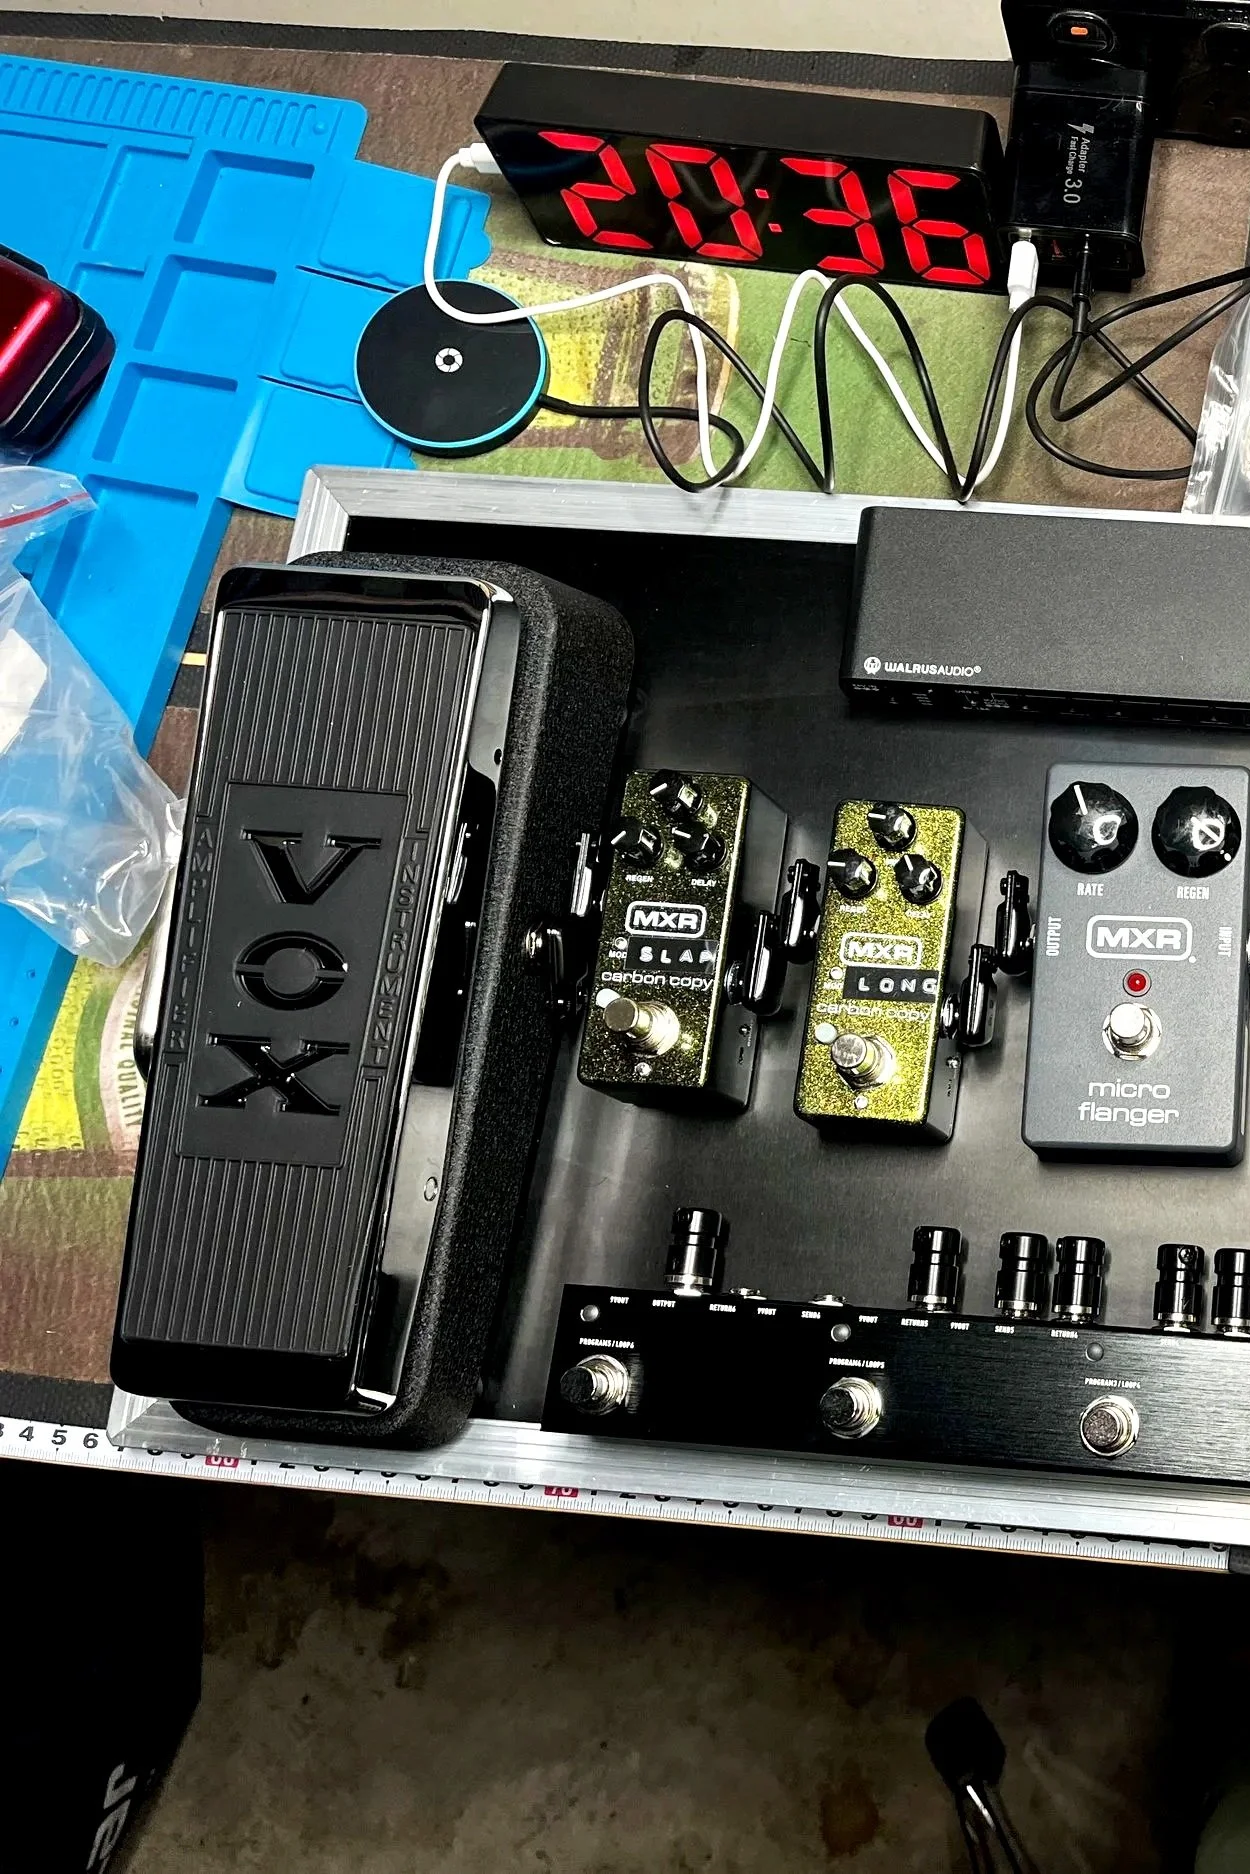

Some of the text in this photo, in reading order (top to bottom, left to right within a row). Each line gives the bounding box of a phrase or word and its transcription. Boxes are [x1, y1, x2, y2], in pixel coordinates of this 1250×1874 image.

[1066, 135, 1079, 175] Fast Charge
[1078, 137, 1091, 173] Adapter
[1063, 178, 1083, 204] 3.0
[539, 131, 991, 285] 20:36
[691, 878, 717, 887] DELAY
[1077, 883, 1104, 897] RATE
[1176, 886, 1210, 900] REGEN
[632, 909, 699, 930] MXR
[169, 828, 213, 1050] AMPLIFIER
[1046, 916, 1062, 957] OUTPUT
[1096, 926, 1182, 950] MXR
[1218, 927, 1232, 958] INPUT
[370, 842, 421, 1064] INSTRUMENT
[608, 949, 628, 959] MOD
[639, 945, 714, 965] SLAP
[848, 941, 913, 961] MXR
[196, 828, 382, 1116] VOX
[601, 970, 714, 992] carbon copy
[858, 976, 938, 995] LONG
[816, 1002, 930, 1024] carbon copy
[1088, 1079, 1171, 1099] micro
[1078, 1101, 1180, 1127] flanger
[652, 1299, 676, 1308] OUTPUT
[19, 1426, 34, 1442] 4
[51, 1429, 68, 1445] 5
[83, 1432, 99, 1449] 6
